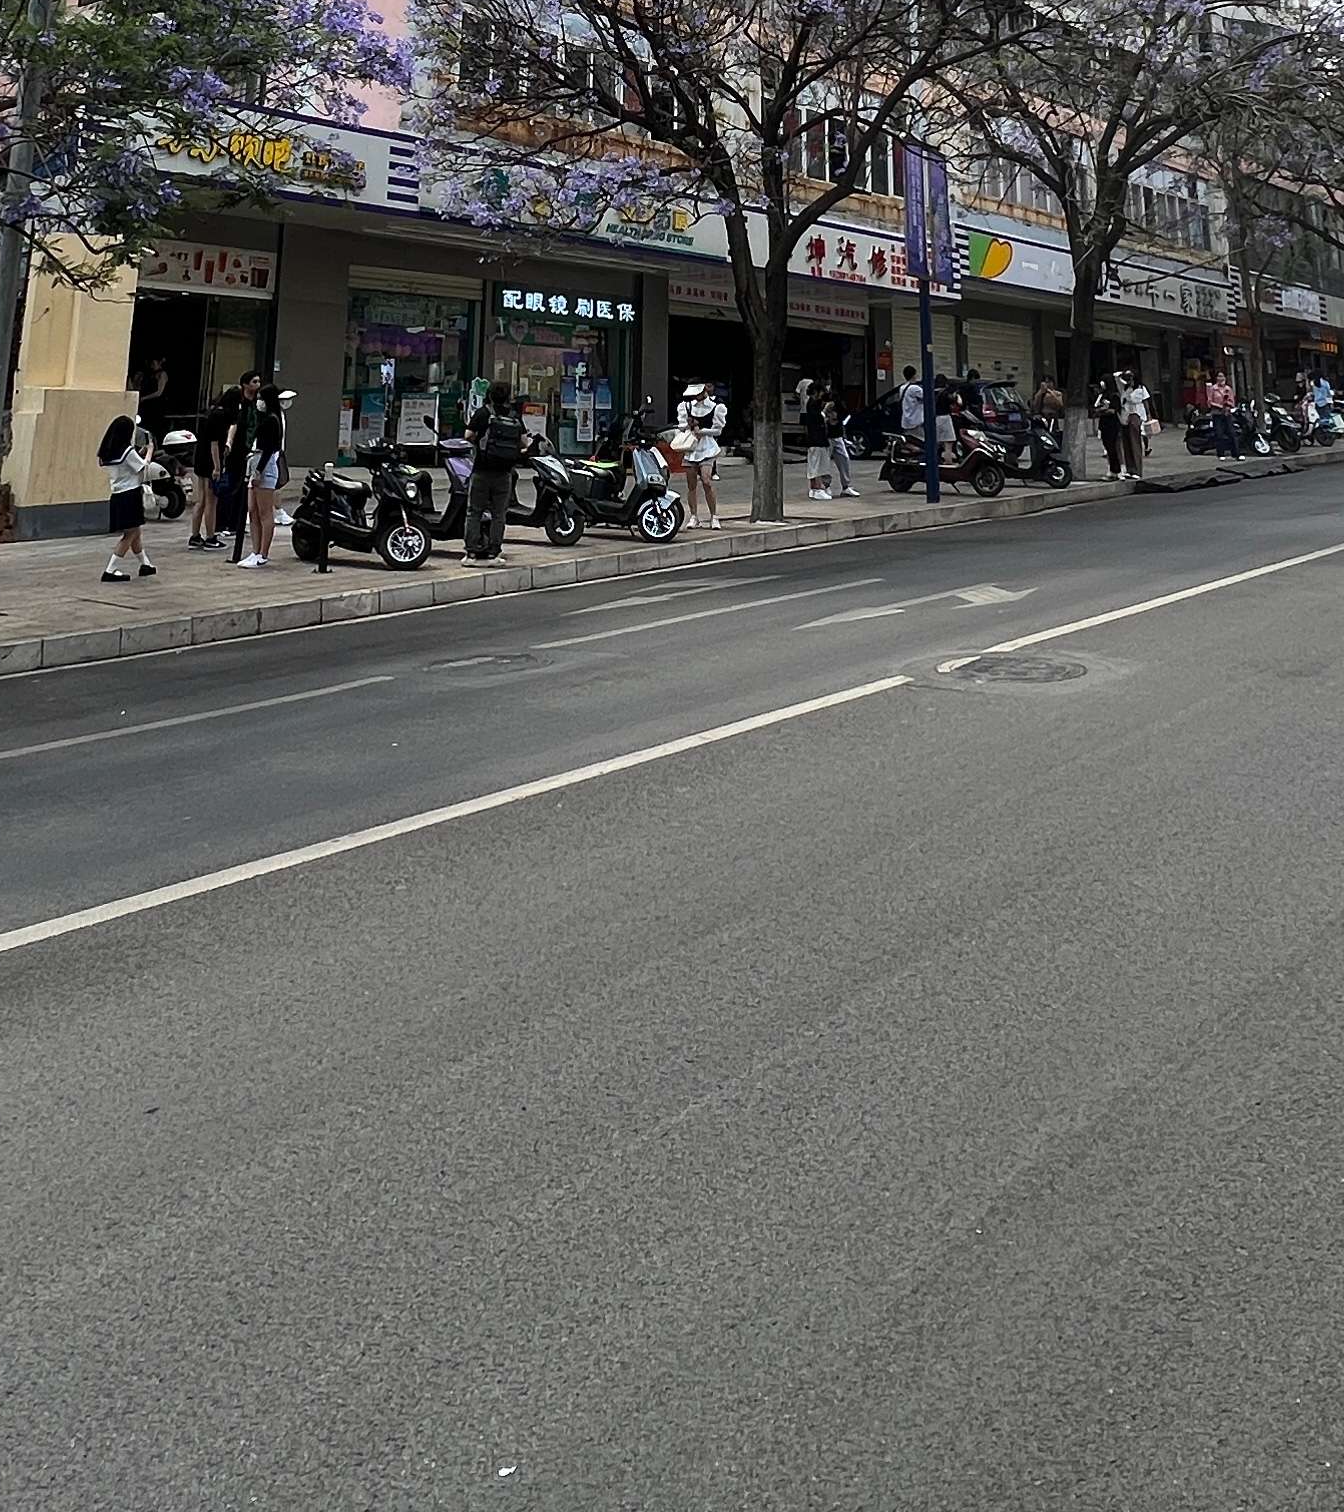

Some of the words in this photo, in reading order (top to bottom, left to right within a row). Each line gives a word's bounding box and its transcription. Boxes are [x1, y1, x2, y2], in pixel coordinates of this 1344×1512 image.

[502, 289, 570, 316] 配眼镜
[574, 297, 636, 323] 刷医保
